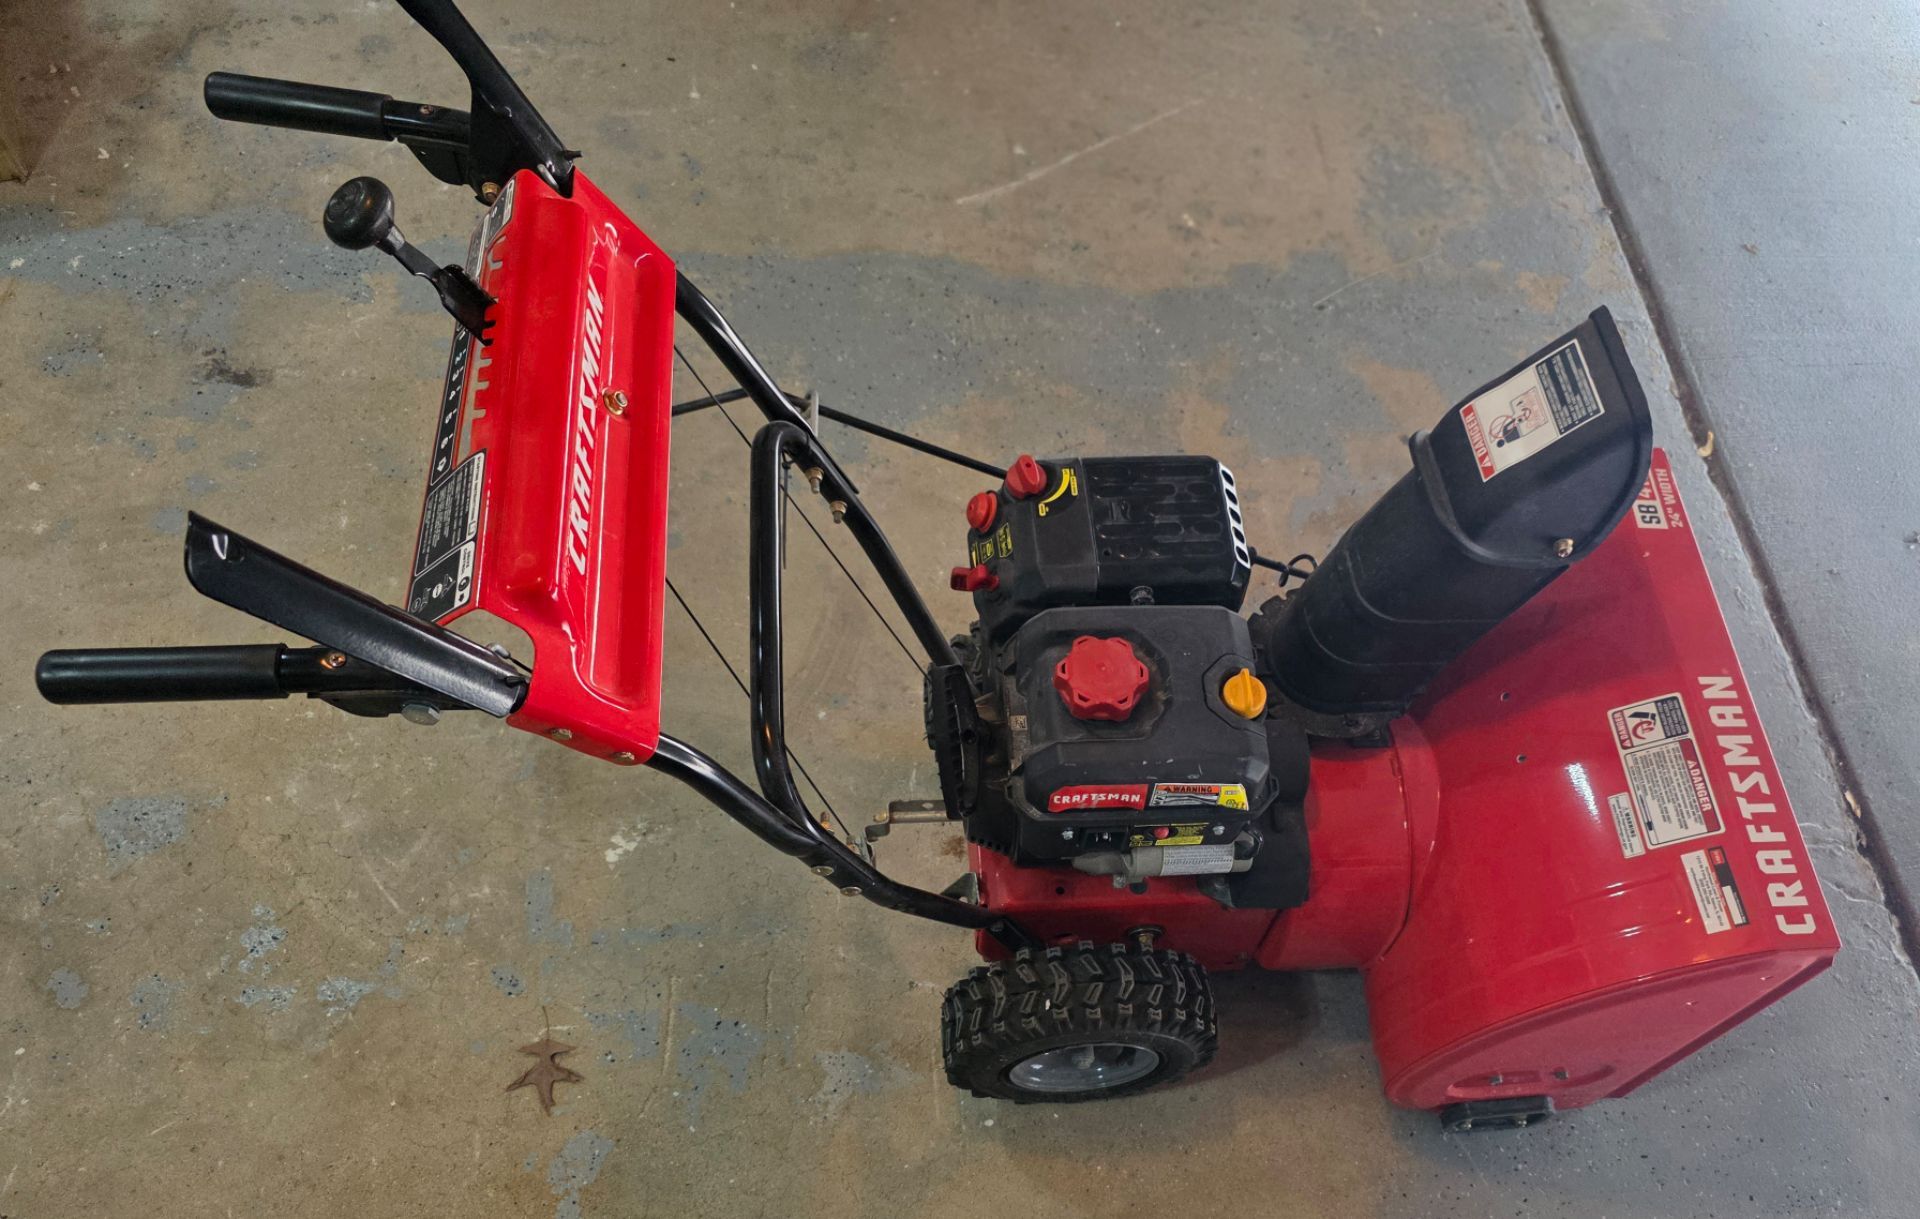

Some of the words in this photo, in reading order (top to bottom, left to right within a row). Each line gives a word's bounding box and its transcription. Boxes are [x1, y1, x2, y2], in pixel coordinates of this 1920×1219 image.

[567, 274, 604, 577] CRAFTSMAN
[1465, 411, 1487, 457] DANGER
[1653, 467, 1677, 505] WIDTH
[1638, 503, 1661, 525] SB
[1613, 711, 1629, 740] DANGER
[1053, 792, 1140, 805] CRAFTSMAN
[1173, 785, 1213, 794] WARNING
[1690, 768, 1712, 812] DANGER
[1697, 676, 1817, 935] CRAFTSMAN
